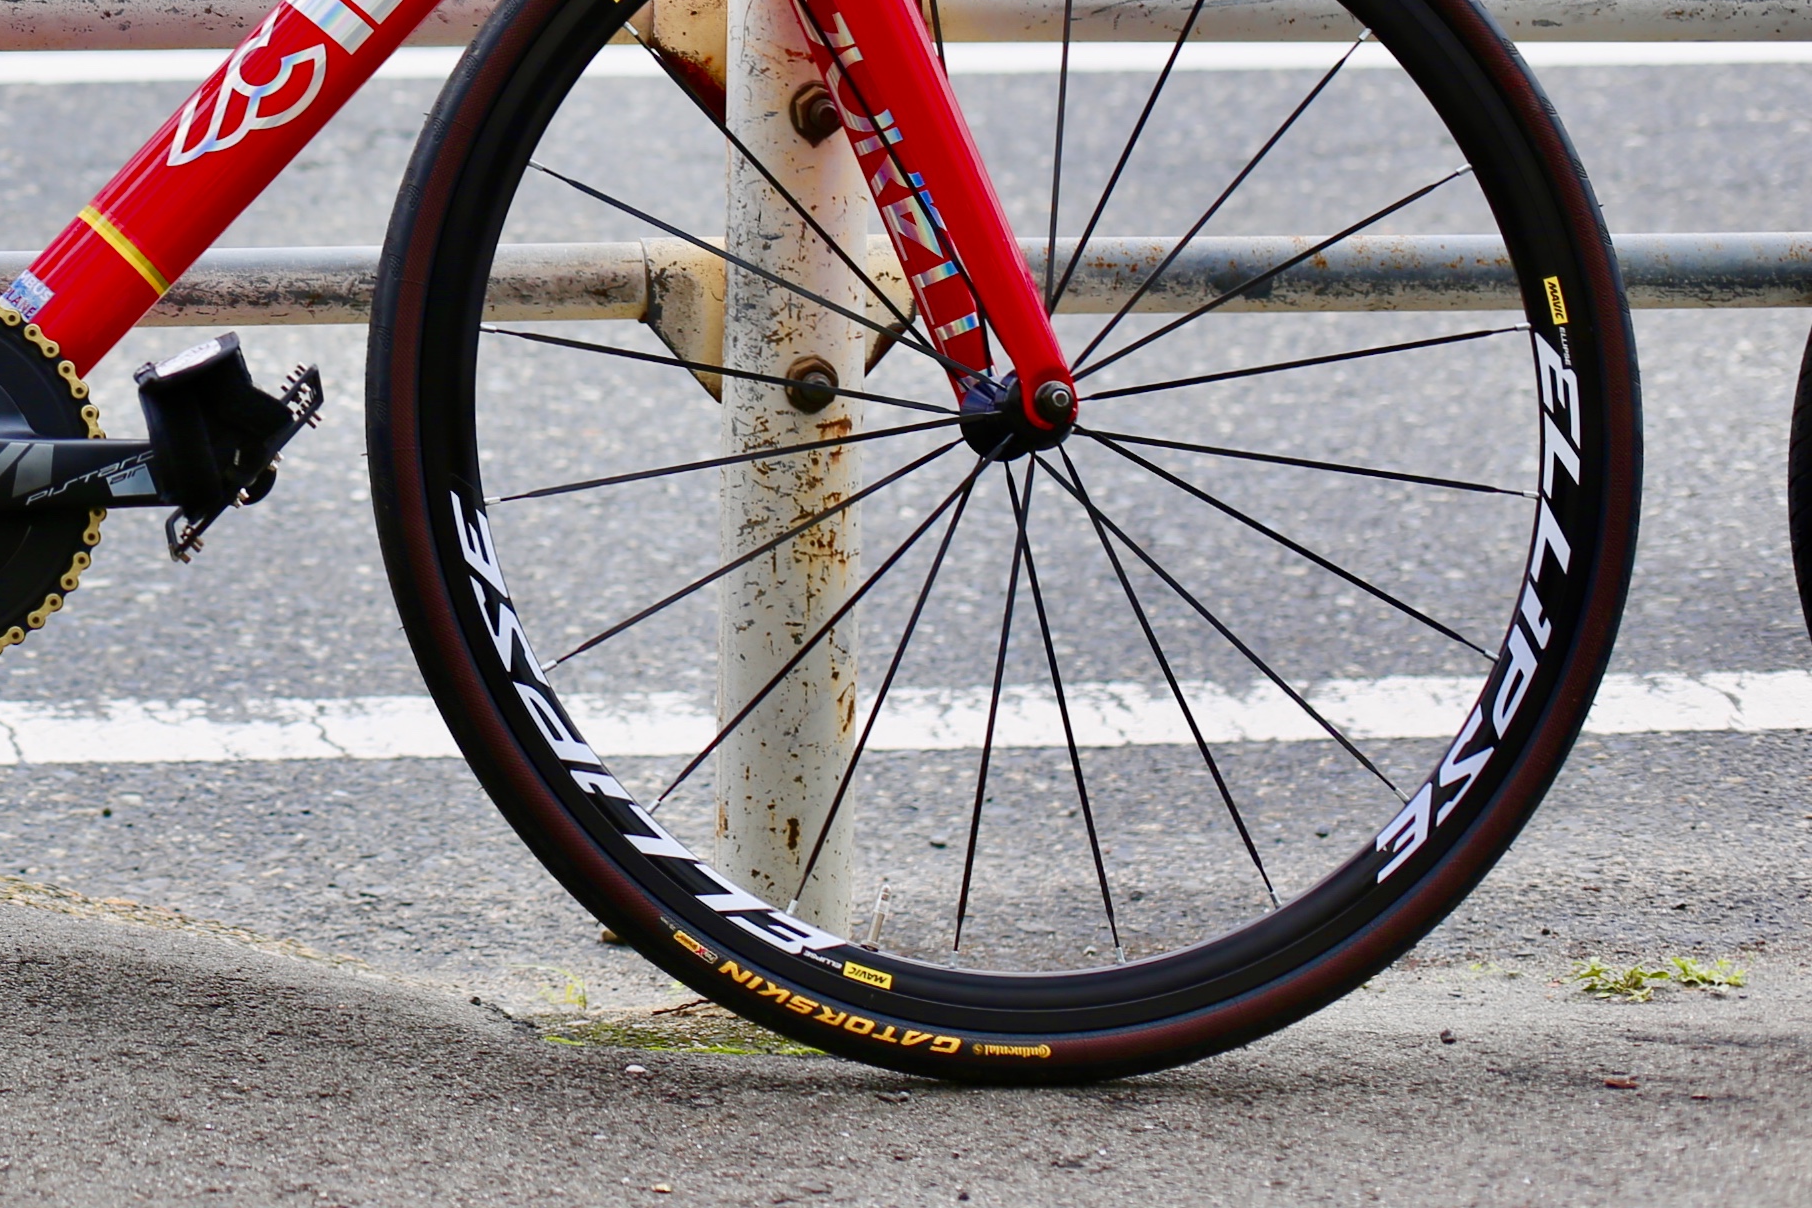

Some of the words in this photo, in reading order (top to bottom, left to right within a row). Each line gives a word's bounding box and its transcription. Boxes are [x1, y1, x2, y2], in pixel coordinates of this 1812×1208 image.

[1545, 279, 1564, 323] MAVIC
[1558, 326, 1572, 366] ELLIPSE
[109, 464, 146, 485] air
[1376, 331, 1582, 885] ELLIPSE
[450, 490, 847, 954] ELLIPSE
[801, 948, 844, 970] ELLIPSE
[846, 964, 890, 988] MAVIC
[717, 959, 963, 1055] GATORSKIN
[982, 1042, 1052, 1059] Continental
